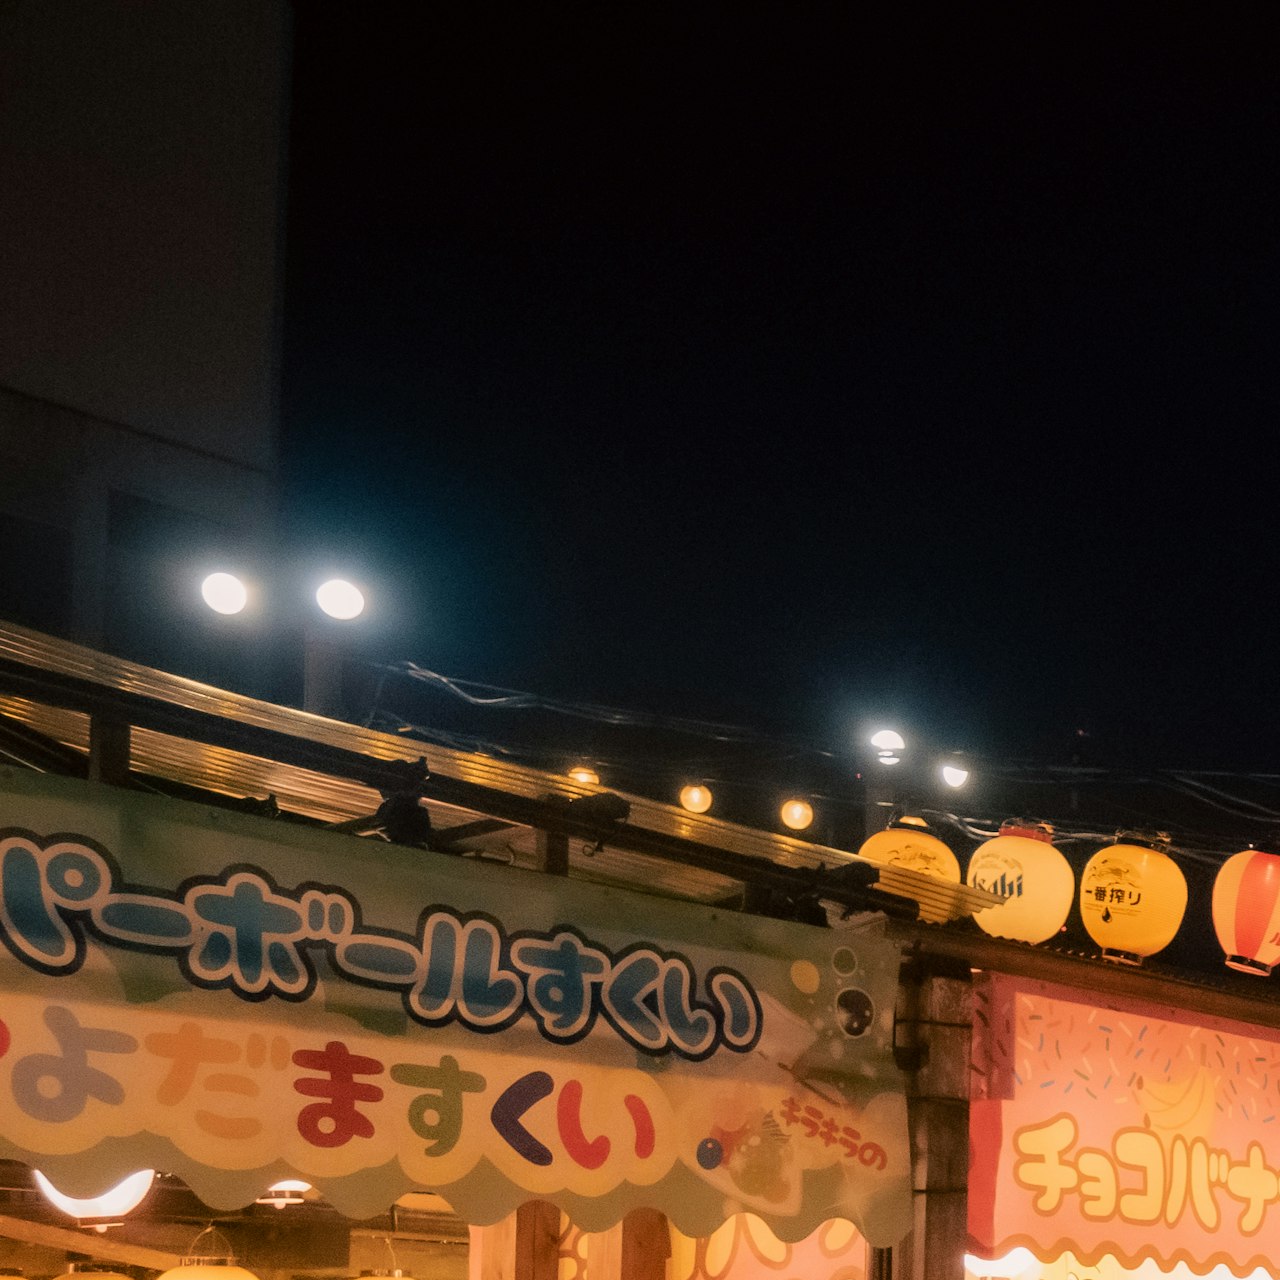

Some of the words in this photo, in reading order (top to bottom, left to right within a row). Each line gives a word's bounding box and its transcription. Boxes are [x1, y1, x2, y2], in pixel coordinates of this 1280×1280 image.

[1085, 886, 1142, 905] 一番搾り
[0, 1005, 656, 1169] よだますくい
[779, 1094, 888, 1171] キラキラの
